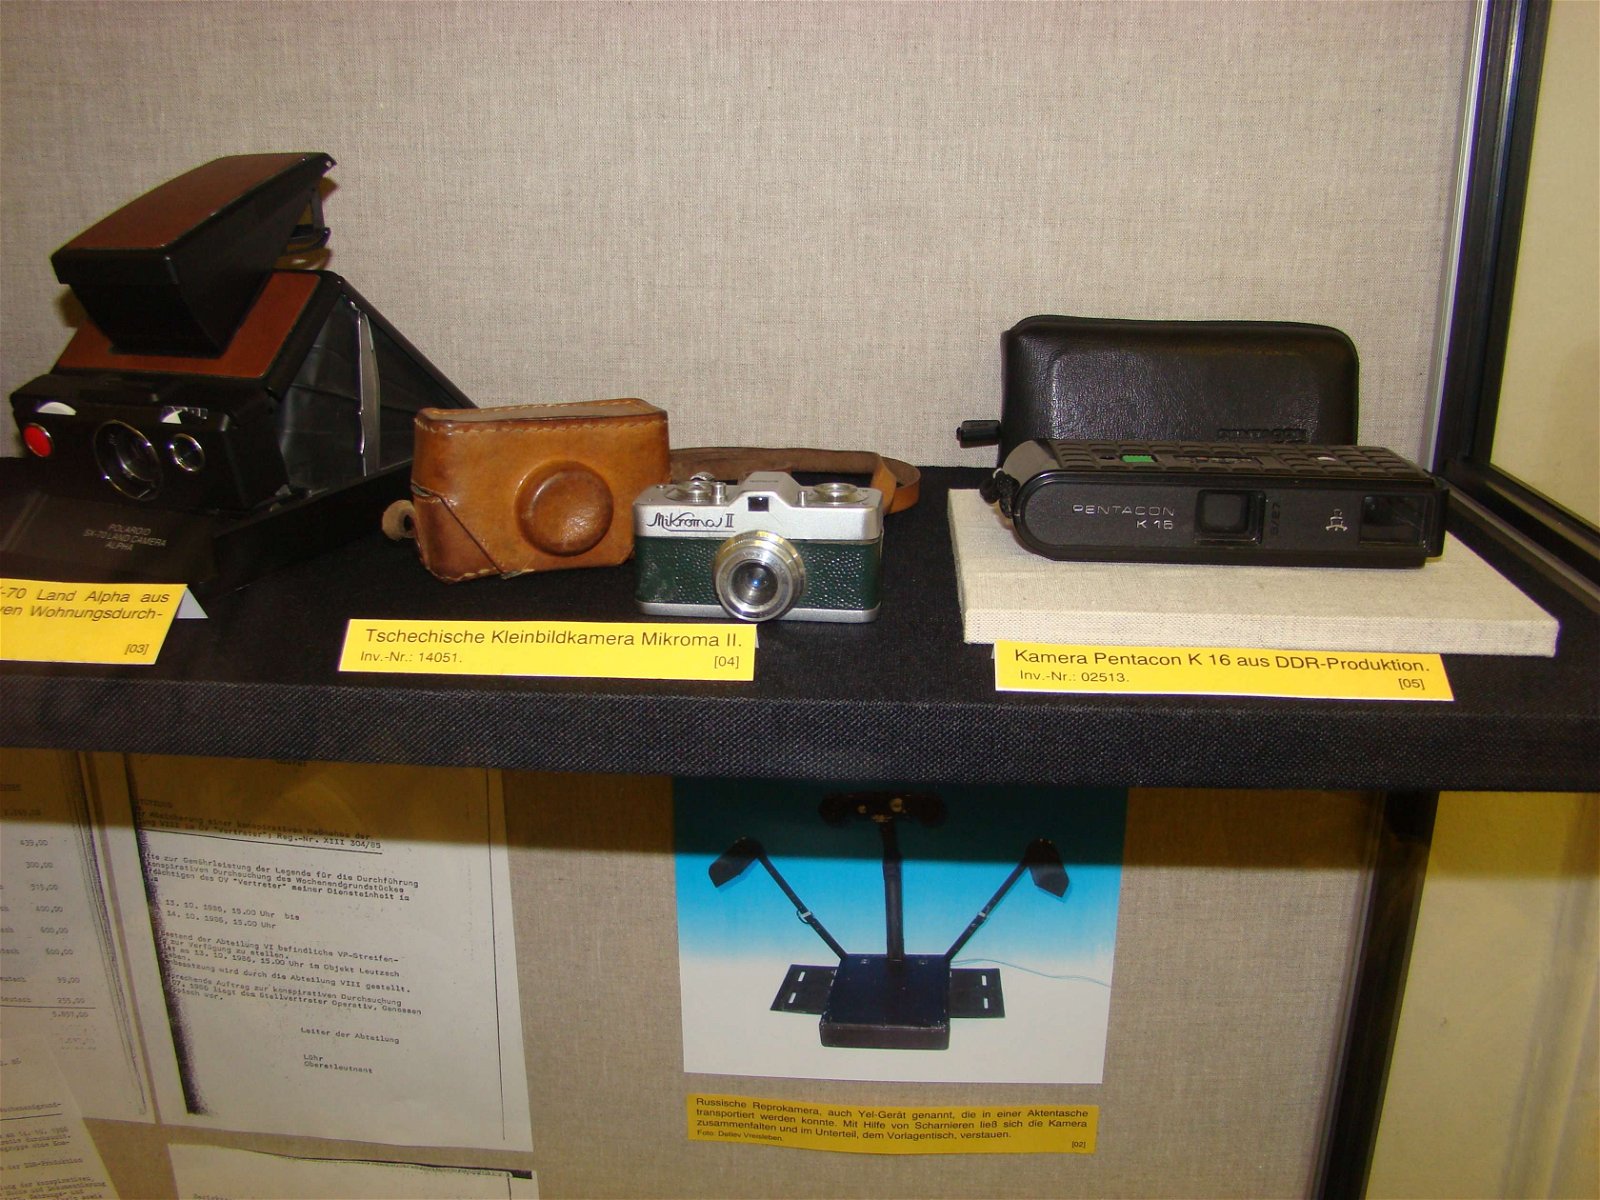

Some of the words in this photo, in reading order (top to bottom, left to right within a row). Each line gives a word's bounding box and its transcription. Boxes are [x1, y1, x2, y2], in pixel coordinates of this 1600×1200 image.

[1072, 504, 1175, 516] PENTACON
[646, 512, 723, 530] Mikroma
[1136, 520, 1147, 529] K
[37, 588, 77, 602] Land
[85, 590, 131, 605] Alpha
[140, 592, 171, 603] aus
[30, 605, 163, 622] Wohnungsdurch-
[366, 628, 485, 643] Tschechische
[491, 629, 635, 646] Kleinbildkamera
[641, 631, 720, 647] Mikroma
[726, 633, 743, 648] II.
[124, 643, 149, 656] [03]
[360, 650, 413, 663] Inv.-Nr.:
[418, 652, 463, 664] 14051.
[714, 655, 740, 670] [04]
[1015, 648, 1088, 665] Kamera
[1094, 651, 1182, 666] Pentacon
[1188, 653, 1203, 666] K
[1209, 654, 1231, 667] 16
[1237, 656, 1271, 668] aus
[1275, 655, 1430, 673] DDR-Produktion.
[1020, 669, 1076, 683] Inv.-Nr.:
[1081, 671, 1130, 683] 02513.
[1398, 677, 1426, 691] [05]
[255, 865, 271, 874] der
[336, 873, 353, 882] die
[356, 875, 419, 889] Durchführung
[271, 972, 288, 981] die
[290, 973, 337, 987] Abteilung
[341, 993, 402, 1008] Durchsuchung
[301, 1026, 331, 1037] Leiter
[335, 1030, 351, 1039] der
[355, 1032, 400, 1045] Abteilung
[696, 1097, 747, 1109] Russische
[753, 1101, 822, 1117] Reprokamera,
[828, 1109, 853, 1118] auch
[912, 1111, 955, 1121] genannt,
[961, 1109, 976, 1119] die
[982, 1108, 991, 1119] in
[997, 1108, 1021, 1118] einer
[1027, 1108, 1089, 1118] Aktentasche
[696, 1108, 755, 1121] transportiert
[760, 1113, 796, 1123] werden
[801, 1116, 838, 1127] konnte.
[843, 1119, 858, 1128] Mit
[863, 1120, 886, 1130] Hilfe
[891, 1122, 909, 1130] von
[915, 1120, 974, 1130] Scharnieren
[980, 1119, 998, 1129] ließ
[1003, 1119, 1023, 1129] sich
[1028, 1119, 1043, 1128] die
[1048, 1118, 1087, 1128] Kamera
[696, 1119, 777, 1132] zusammenfalten
[780, 1123, 798, 1133] und
[801, 1126, 812, 1134] im
[815, 1127, 859, 1140] Unterteil,
[862, 1131, 885, 1140] dem
[887, 1131, 957, 1142] Vorlagentisch,
[961, 1130, 1012, 1139] verstauen.
